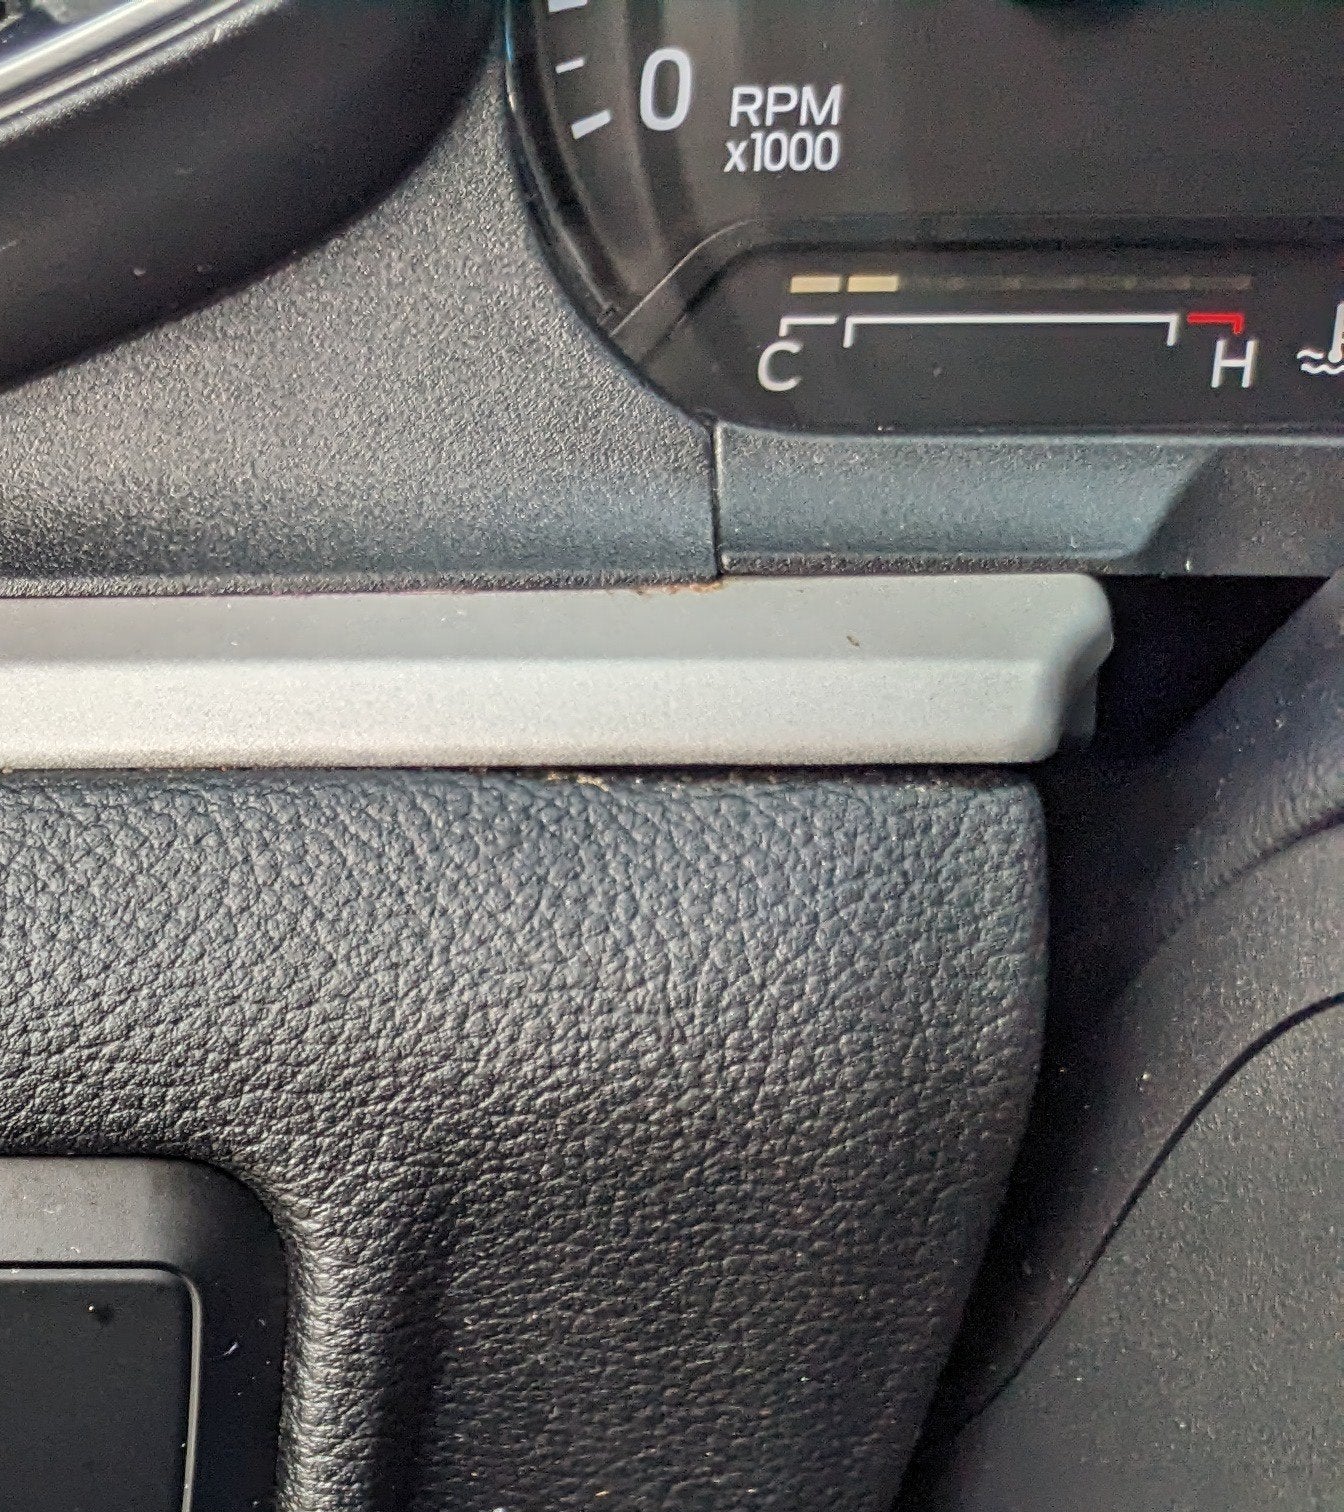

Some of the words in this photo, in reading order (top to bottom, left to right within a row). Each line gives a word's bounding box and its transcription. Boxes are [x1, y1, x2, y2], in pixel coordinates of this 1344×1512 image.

[639, 46, 693, 131] 0
[729, 84, 843, 127] RPM
[723, 131, 841, 173] x1000
[757, 340, 803, 393] C
[1211, 339, 1258, 389] H
